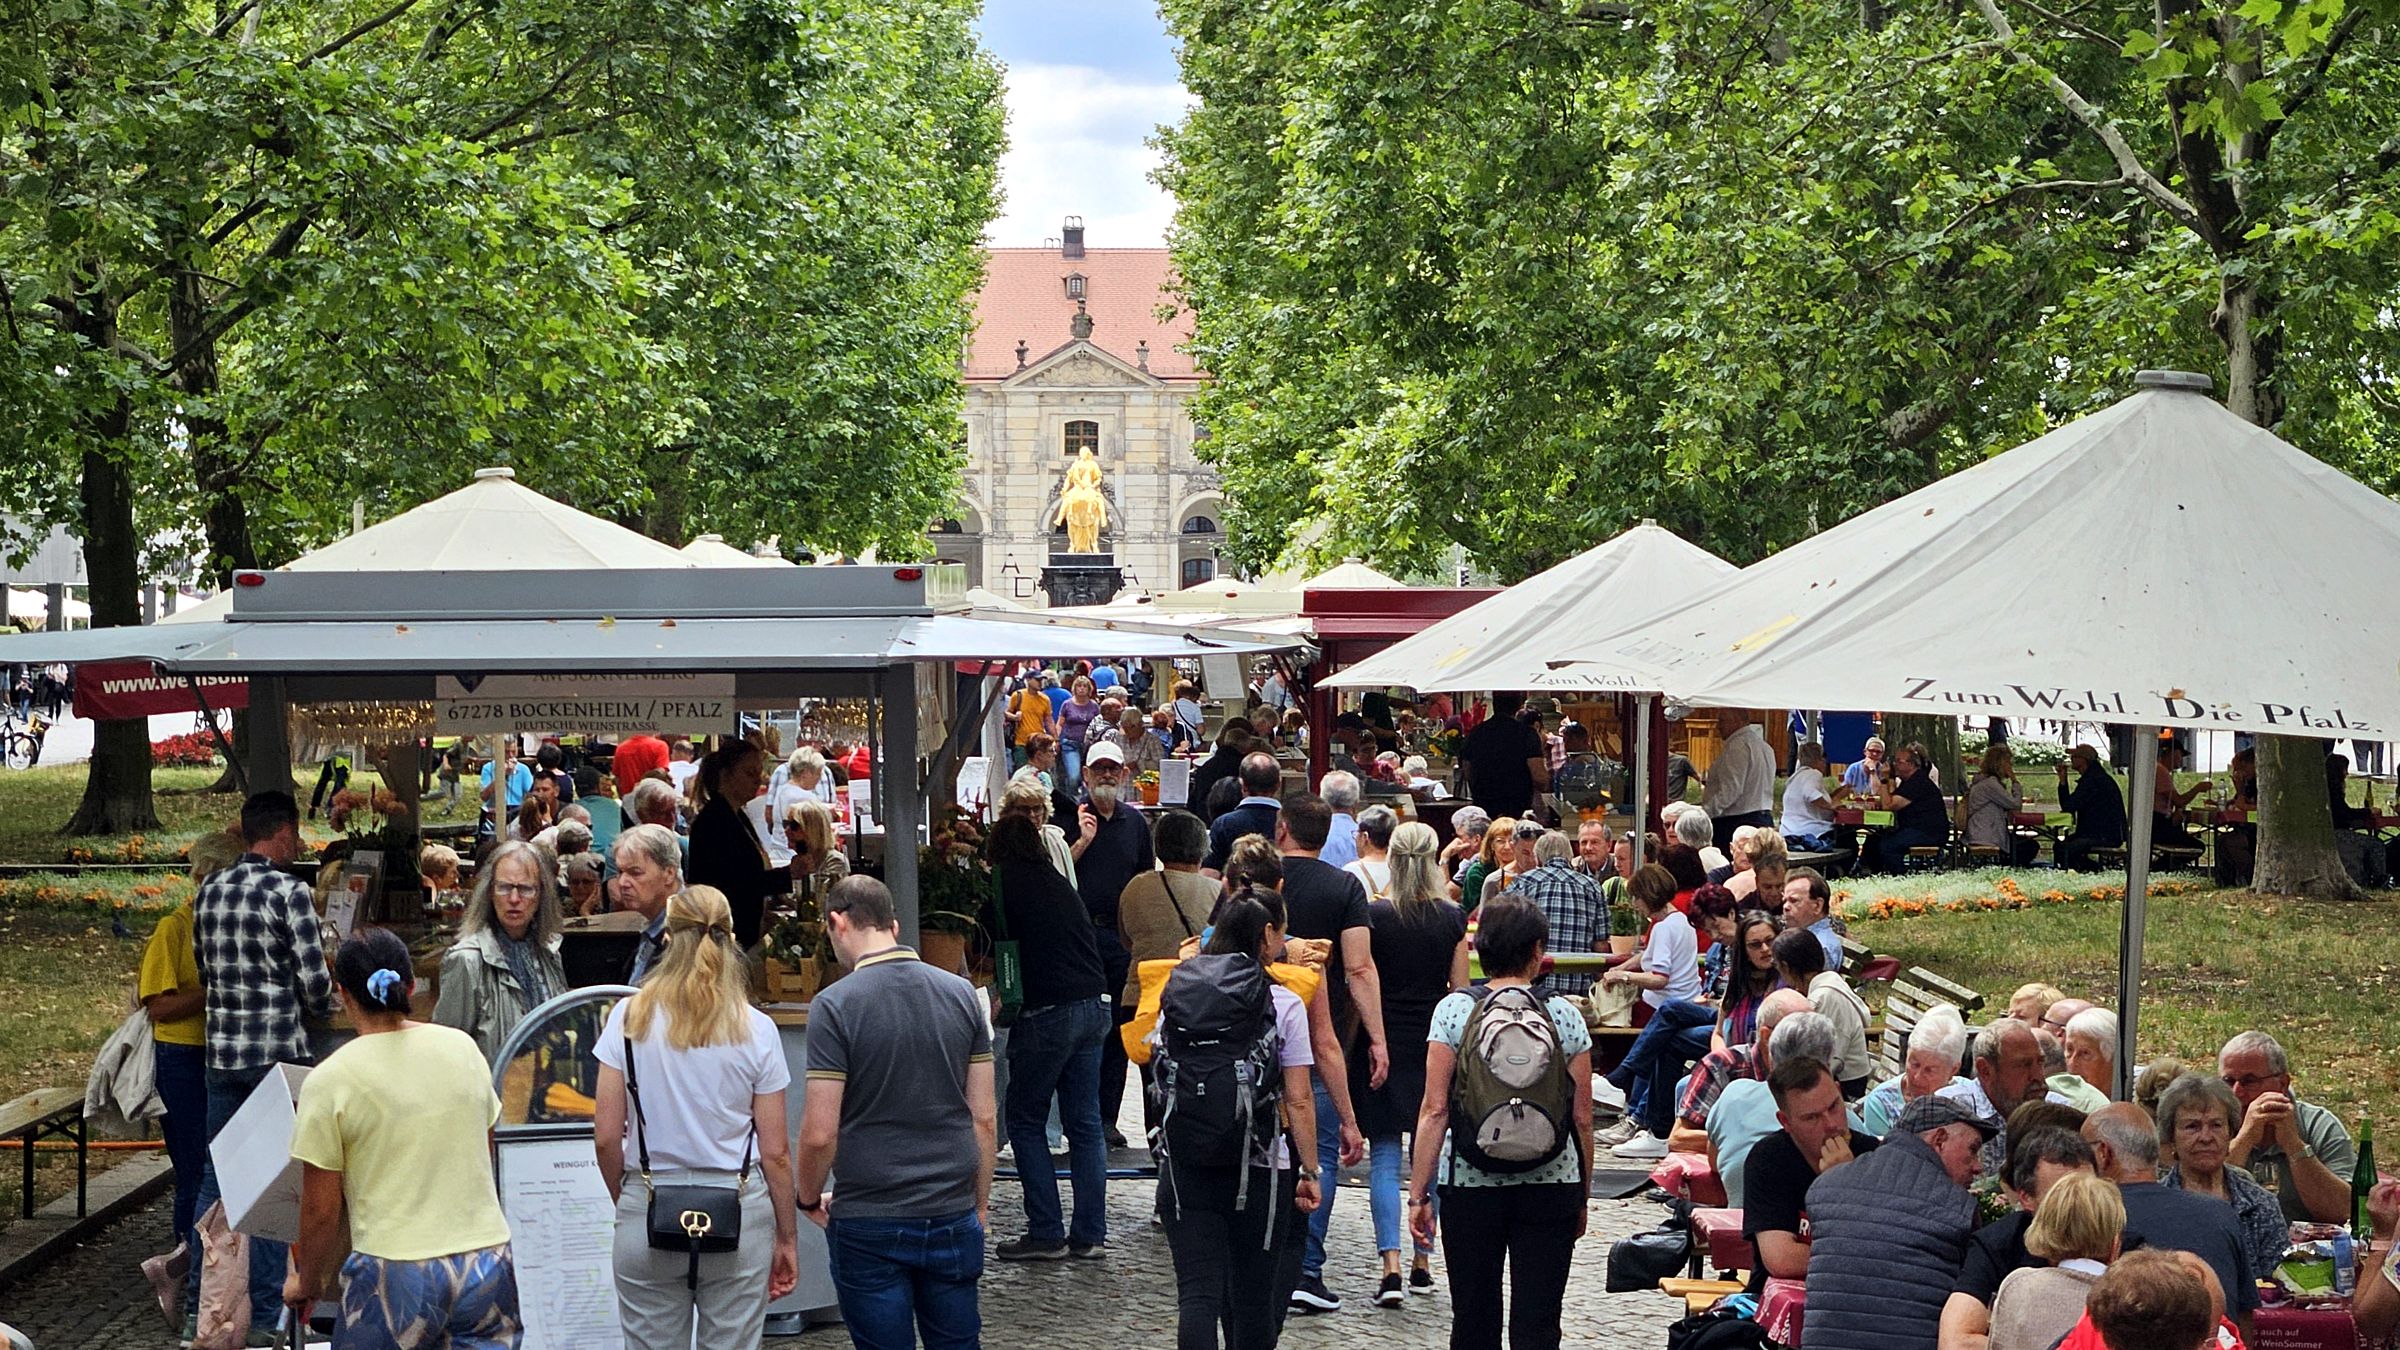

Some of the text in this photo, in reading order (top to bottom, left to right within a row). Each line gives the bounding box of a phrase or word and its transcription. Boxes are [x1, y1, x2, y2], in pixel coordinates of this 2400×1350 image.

[1902, 677, 2383, 733] Zum Wohl. Die Pfalz.
[448, 703, 503, 720] 67278
[510, 702, 640, 718] BOCKENHEIM
[662, 702, 722, 718] PFALZ
[515, 720, 658, 731] DEUTSCHE WEINSTRASSE
[553, 1160, 590, 1169] WEINGUT
[2260, 1327, 2283, 1336] auch
[2284, 1327, 2300, 1336] auf
[2260, 1339, 2323, 1349] WeinSommer
